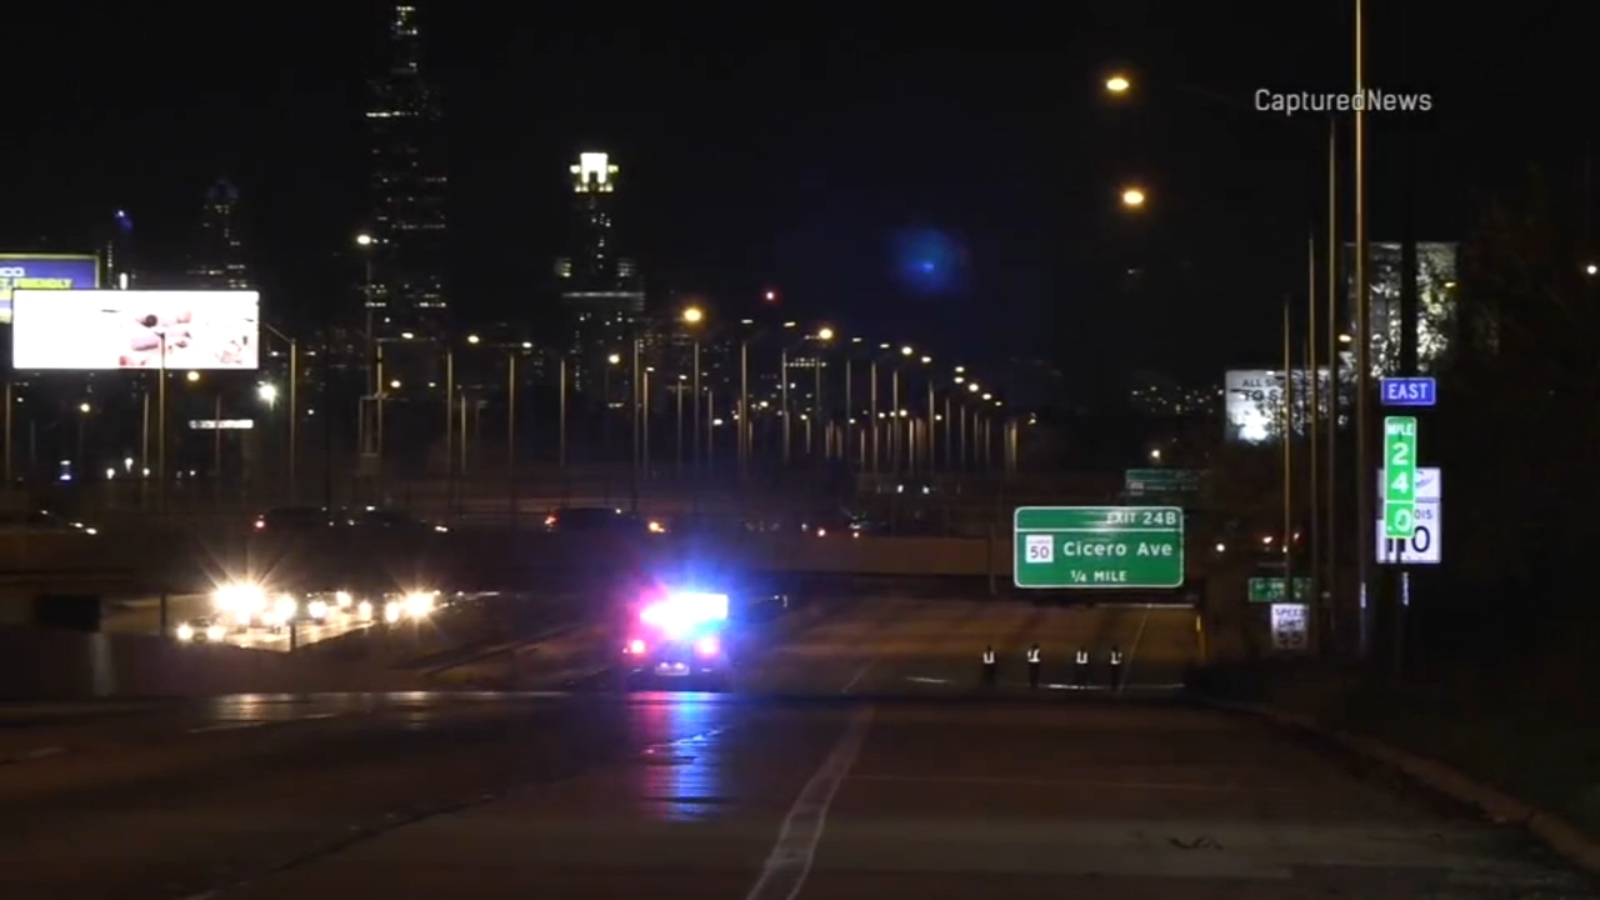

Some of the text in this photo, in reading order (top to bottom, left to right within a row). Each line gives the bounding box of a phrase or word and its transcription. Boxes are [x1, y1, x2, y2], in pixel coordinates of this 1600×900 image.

[1388, 383, 1428, 400] EAST
[1106, 512, 1177, 525] EXIT 24B
[1029, 545, 1050, 559] 50
[1063, 541, 1127, 556] Cicero
[1136, 542, 1173, 556] Ave
[1094, 570, 1127, 582] MILE
[1275, 608, 1307, 617] SPEED
